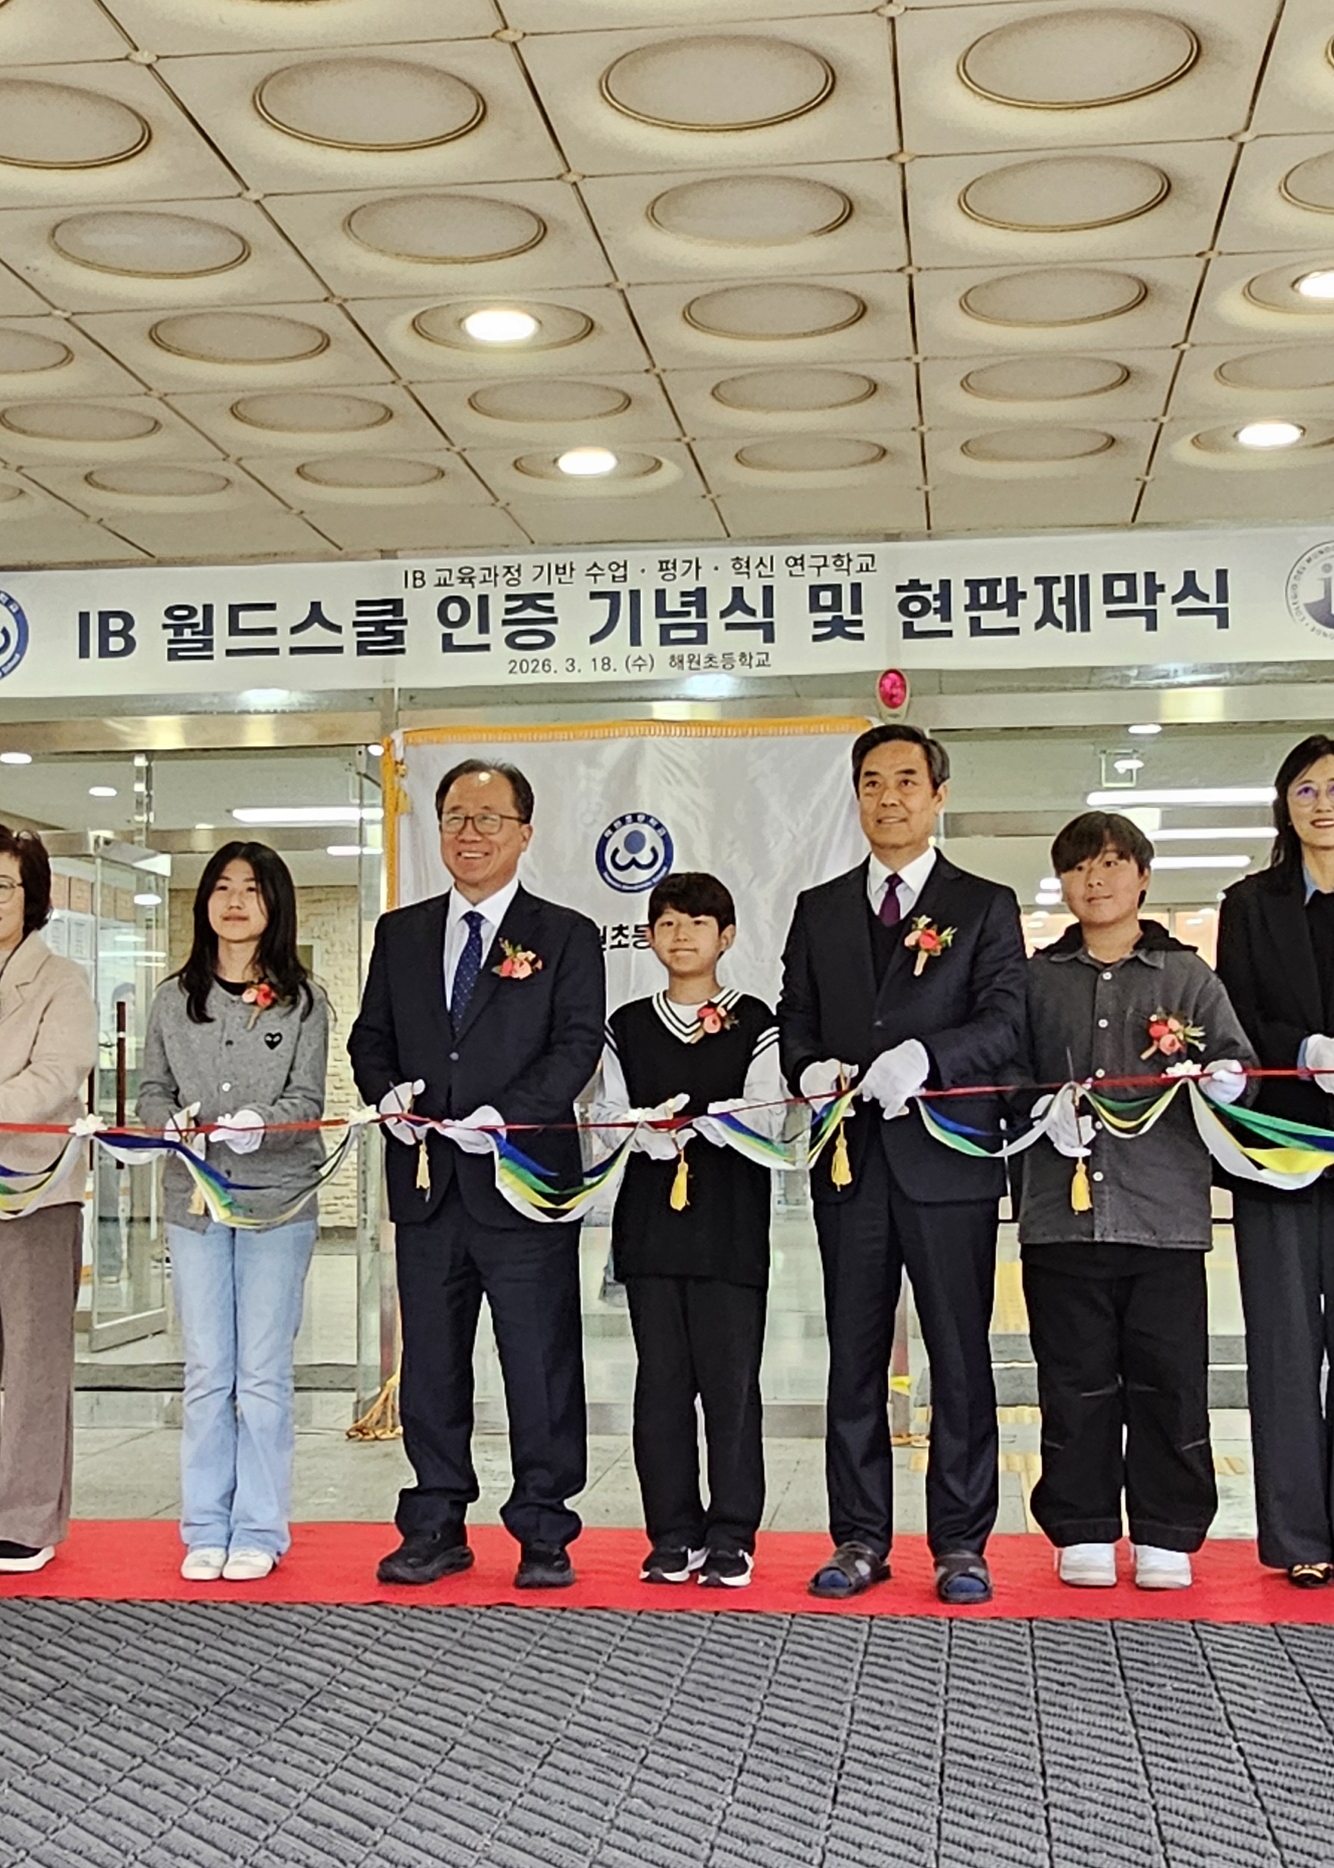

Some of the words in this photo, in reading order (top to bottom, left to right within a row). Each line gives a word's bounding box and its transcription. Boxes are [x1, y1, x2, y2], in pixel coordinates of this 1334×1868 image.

[404, 569, 427, 589] IB
[433, 564, 522, 588] 교육과정
[532, 561, 575, 585] 기반
[584, 559, 629, 584] 수업
[657, 557, 702, 582] 평가
[730, 554, 776, 579] 혁신
[784, 552, 877, 578] 연구학교
[78, 610, 137, 660] IB
[161, 598, 408, 662] 월드스쿨
[436, 592, 559, 653] 인증
[589, 585, 776, 647] 기념식
[808, 581, 865, 643] 및
[895, 568, 1229, 640] 현판제막식
[507, 657, 558, 675] 2026.
[565, 657, 582, 674] 3.
[591, 656, 618, 673] 18.
[624, 654, 656, 673] (수)
[668, 651, 772, 672] 해원초등학교
